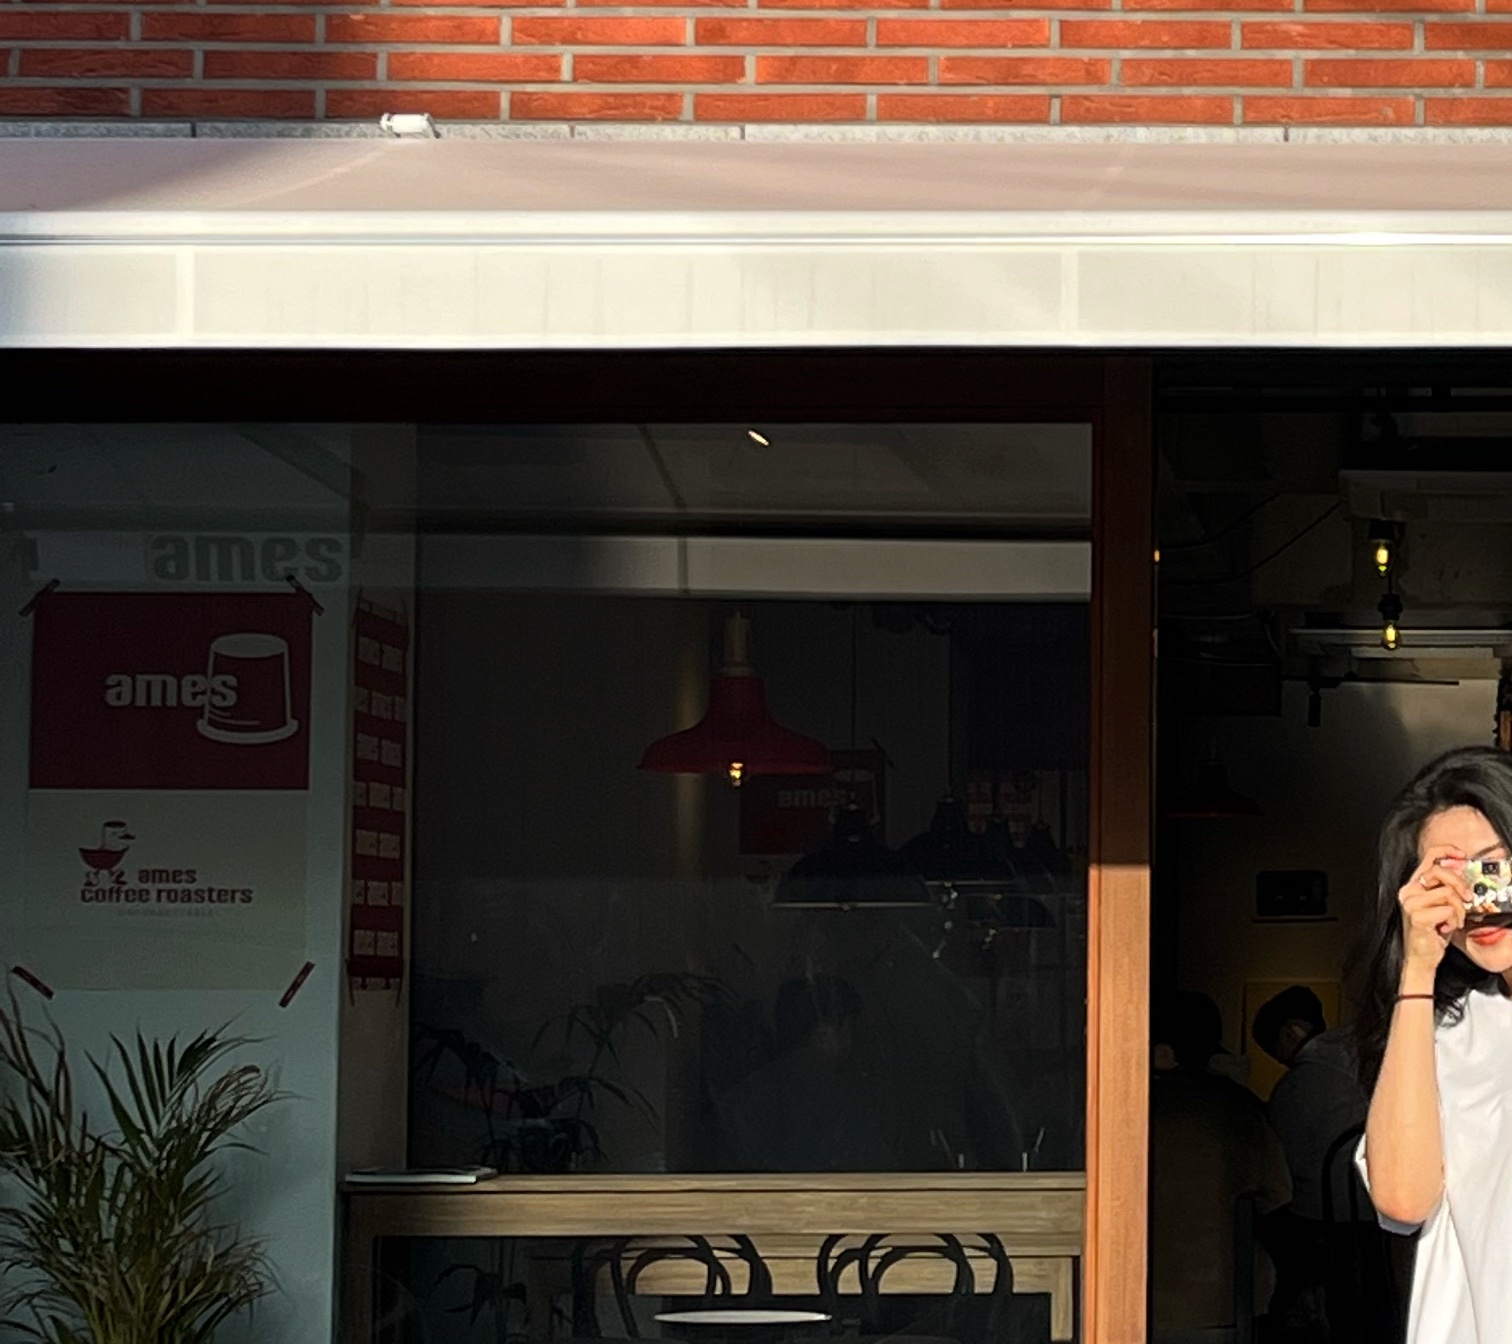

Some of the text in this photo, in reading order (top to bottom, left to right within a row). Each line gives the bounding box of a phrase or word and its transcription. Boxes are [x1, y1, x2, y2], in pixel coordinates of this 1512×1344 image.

[105, 673, 238, 708] ames
[138, 868, 197, 884] ames
[81, 887, 253, 904] coffee roasters
